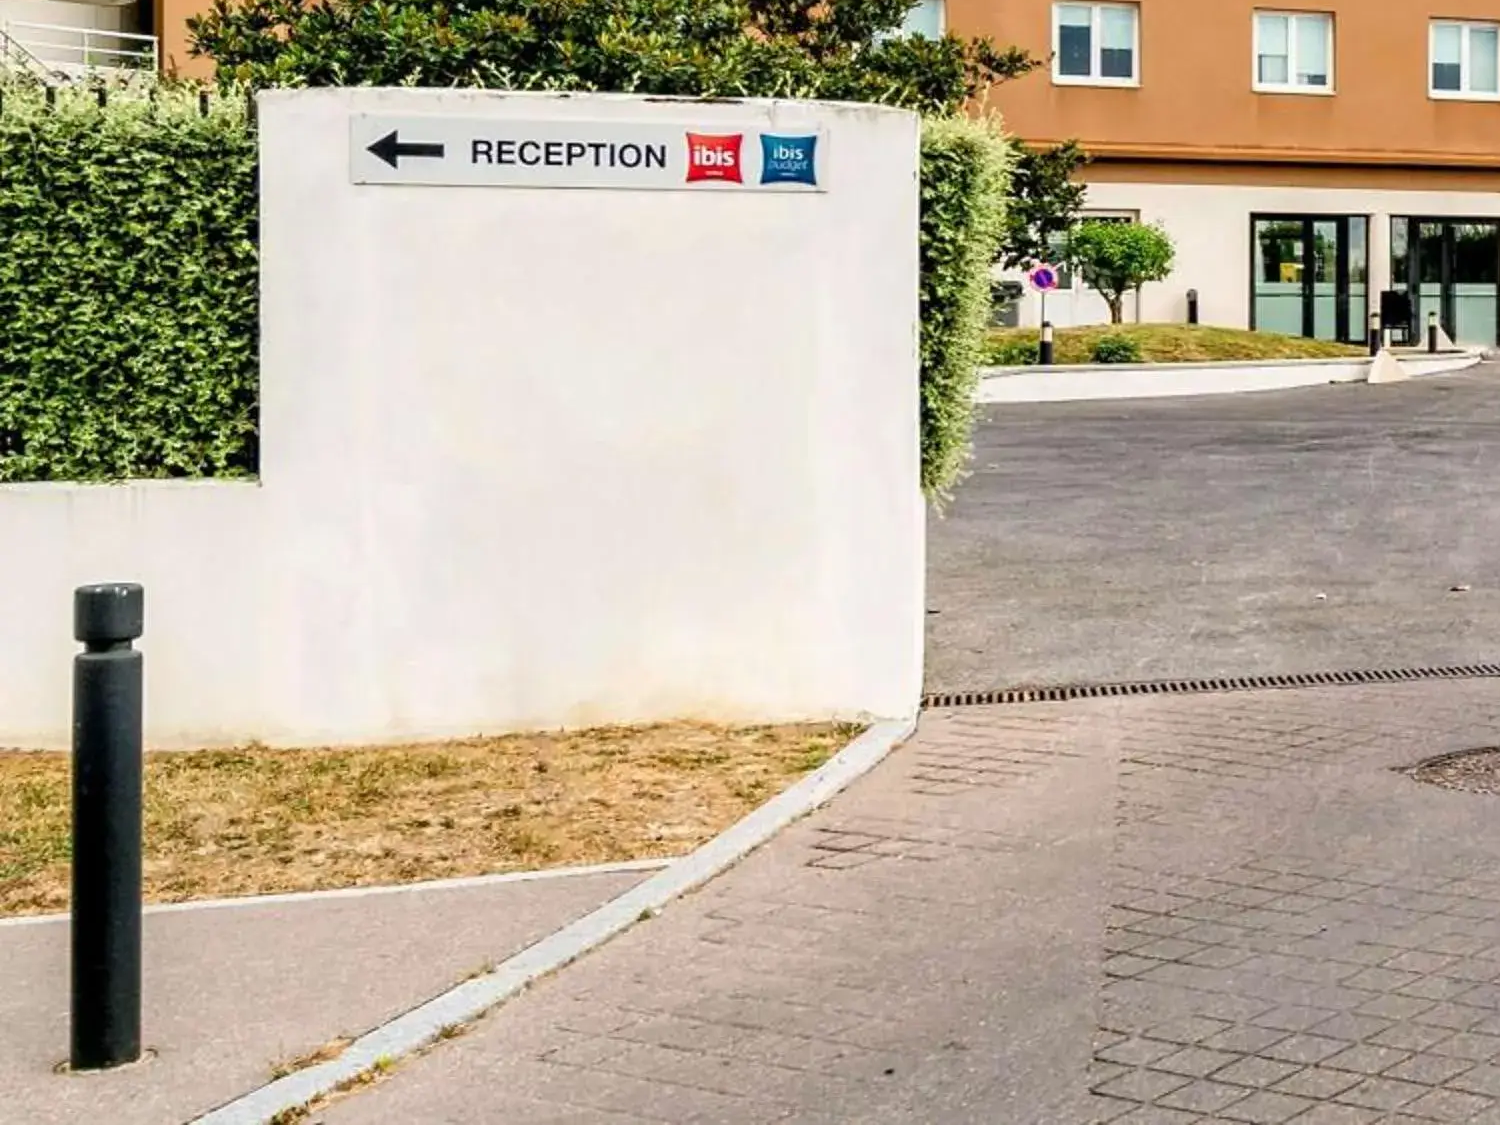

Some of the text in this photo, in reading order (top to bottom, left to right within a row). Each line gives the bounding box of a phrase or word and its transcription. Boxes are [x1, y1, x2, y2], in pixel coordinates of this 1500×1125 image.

[472, 140, 666, 168] RECEPTION
[693, 145, 735, 166] ibis
[774, 144, 804, 160] ibis
